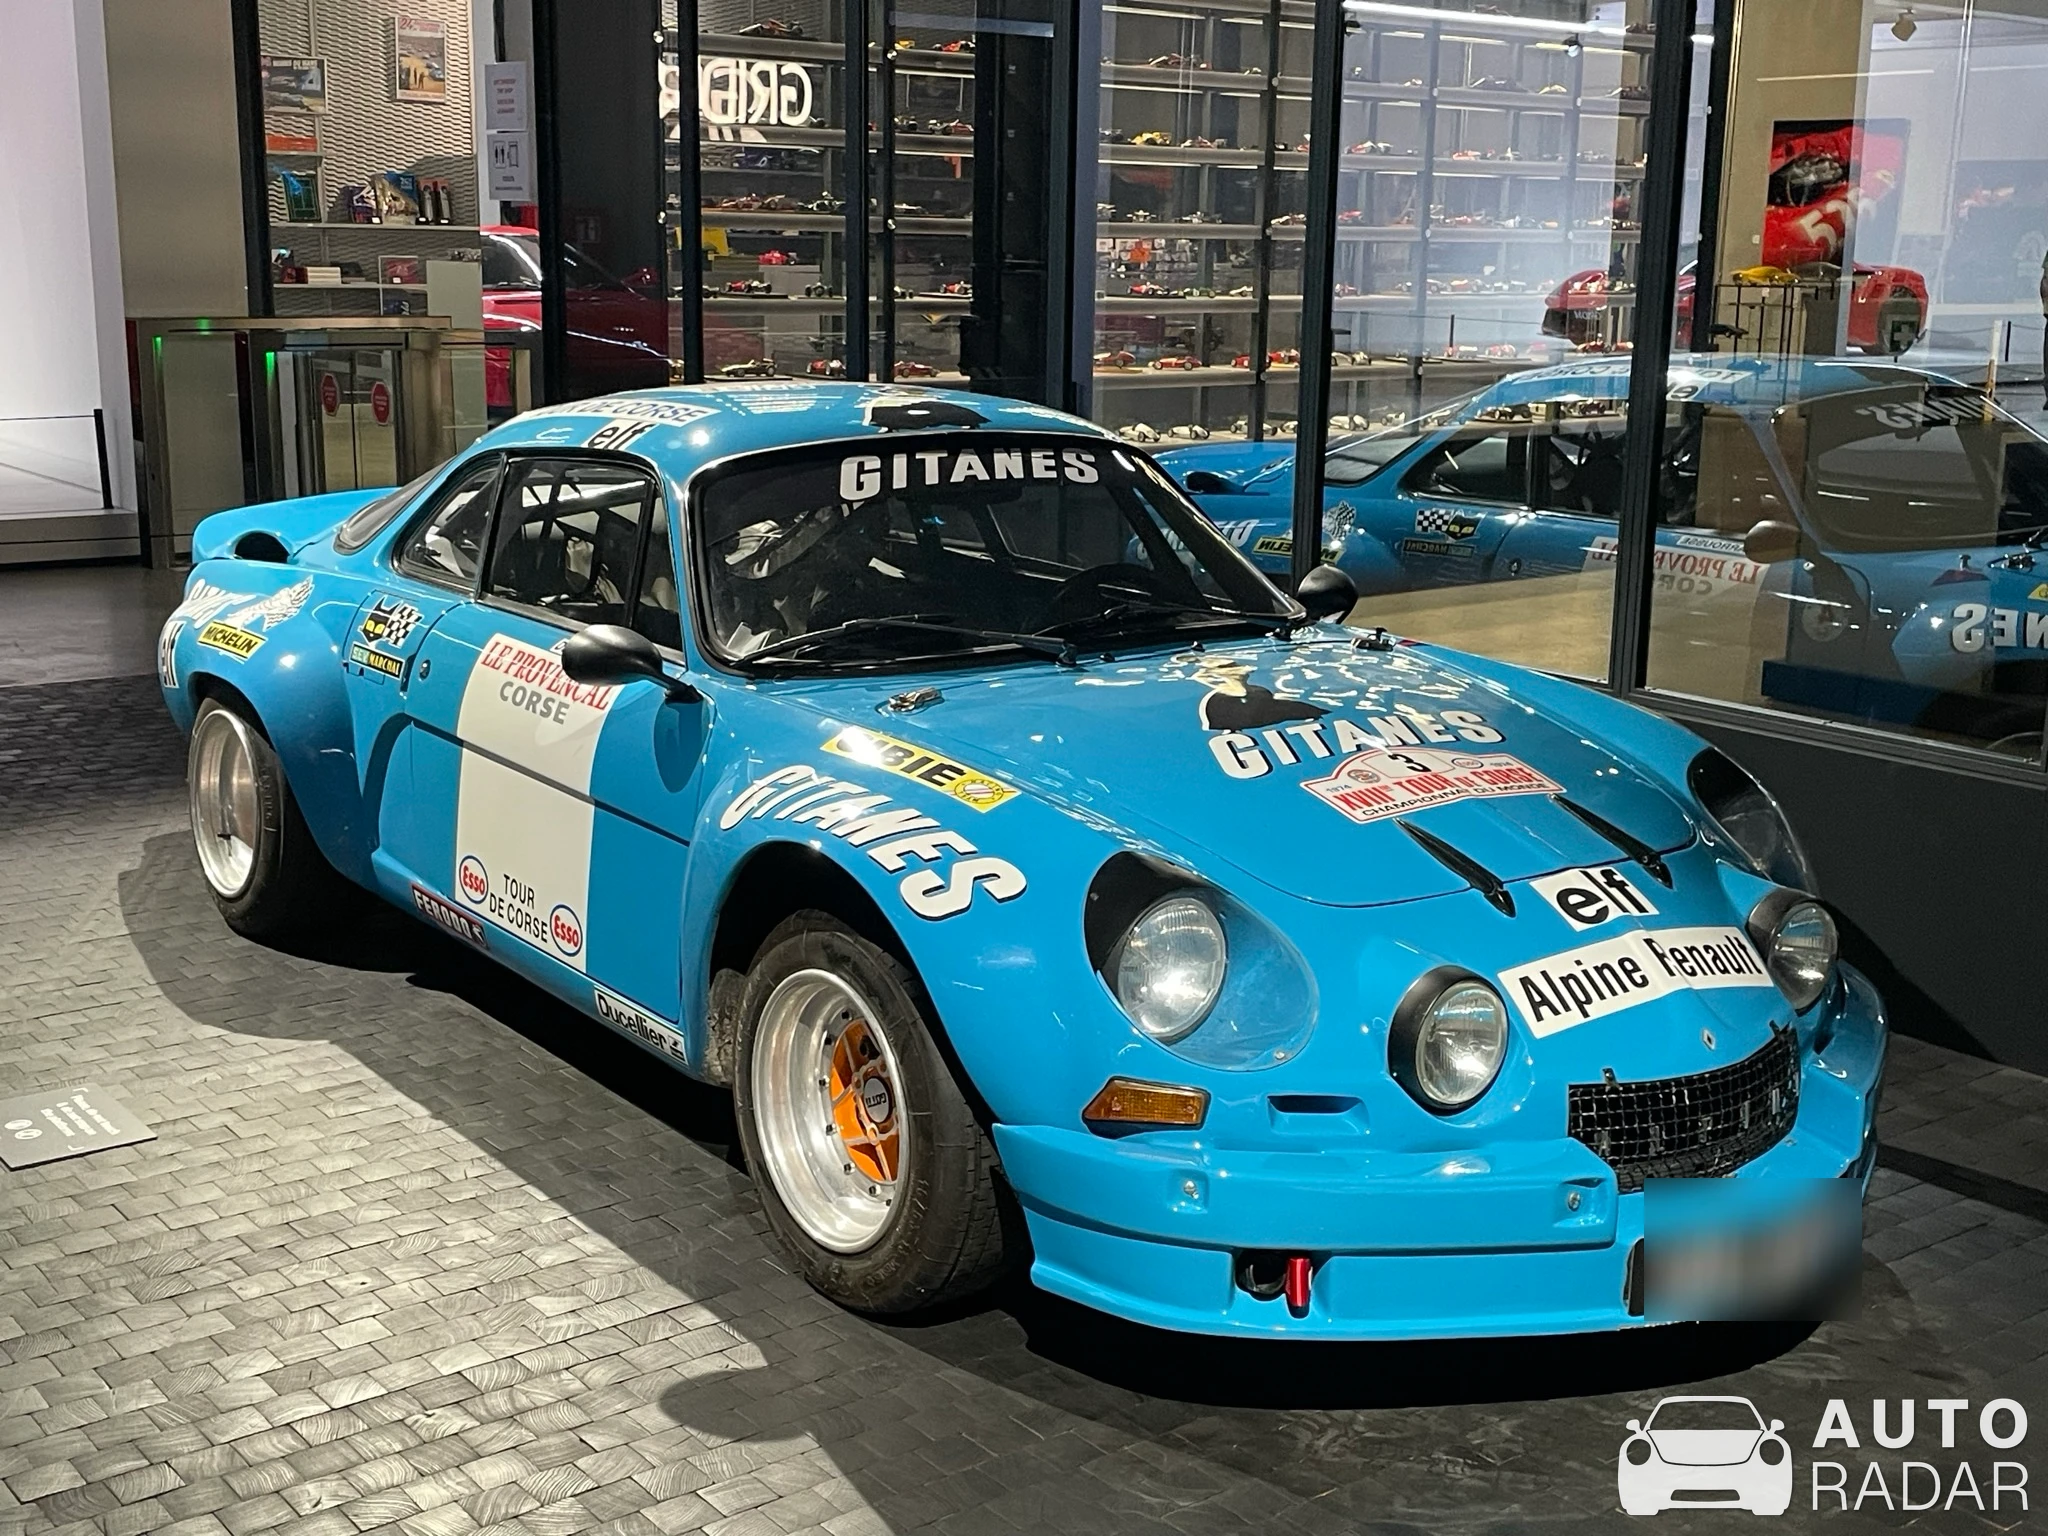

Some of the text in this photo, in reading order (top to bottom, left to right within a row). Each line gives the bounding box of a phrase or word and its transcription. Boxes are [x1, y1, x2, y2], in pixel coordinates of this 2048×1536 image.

[612, 401, 707, 423] CORSE
[587, 421, 656, 450] elf
[839, 447, 1099, 501] GITANES
[202, 625, 258, 654] MICHELIN
[480, 641, 513, 671] LE
[499, 680, 571, 725] CORSE
[1208, 709, 1506, 780] GITANES
[1387, 753, 1433, 773] 3
[1361, 783, 1551, 817] CHAMPIONNAT DU MONDE
[1392, 772, 1462, 797] TOUR
[1453, 776, 1483, 788] DE
[1469, 767, 1544, 786] CORSE
[719, 764, 1028, 922] GITANES
[413, 888, 473, 939] FERODO
[503, 874, 535, 910] TOUR
[1555, 869, 1650, 925] elf
[489, 892, 548, 944] DE CORSE
[1518, 934, 1763, 1022] Alpine Renault
[597, 992, 668, 1050] Ducellier
